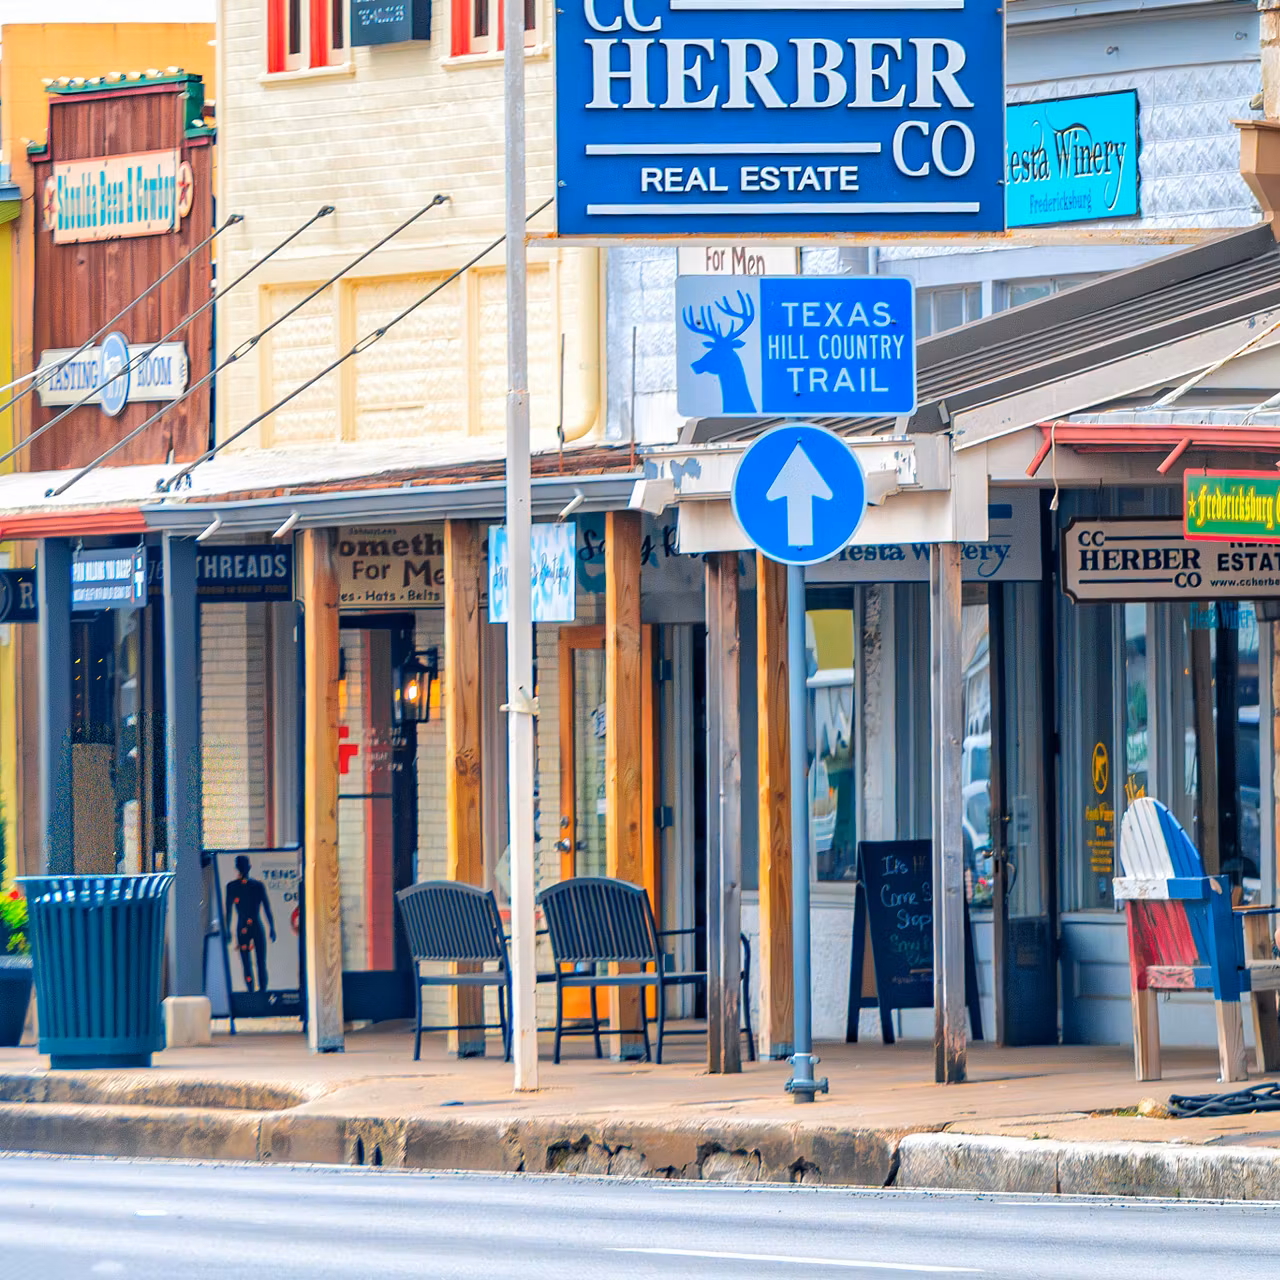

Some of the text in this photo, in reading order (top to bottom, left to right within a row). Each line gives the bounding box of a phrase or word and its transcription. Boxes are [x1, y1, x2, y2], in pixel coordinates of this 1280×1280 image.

[584, 37, 975, 109] HERBER
[892, 119, 976, 177] CO
[641, 165, 859, 192] REAL ESTATE
[1050, 122, 1127, 211] Winery
[127, 167, 134, 223] A
[1029, 189, 1092, 214] Fredericksburg
[706, 246, 766, 276] For Men
[781, 301, 891, 327] TEXAS
[768, 333, 905, 360] HILL COUNTRY
[137, 356, 172, 387] ROOM
[787, 367, 889, 393] TRAIL
[1196, 485, 1274, 529] Fredericksburg
[1078, 531, 1104, 547] CC
[1079, 549, 1202, 571] HERBER
[352, 560, 445, 588] For Me
[1174, 572, 1202, 588] CO
[365, 591, 396, 602] Hats
[408, 589, 440, 602] Belts
